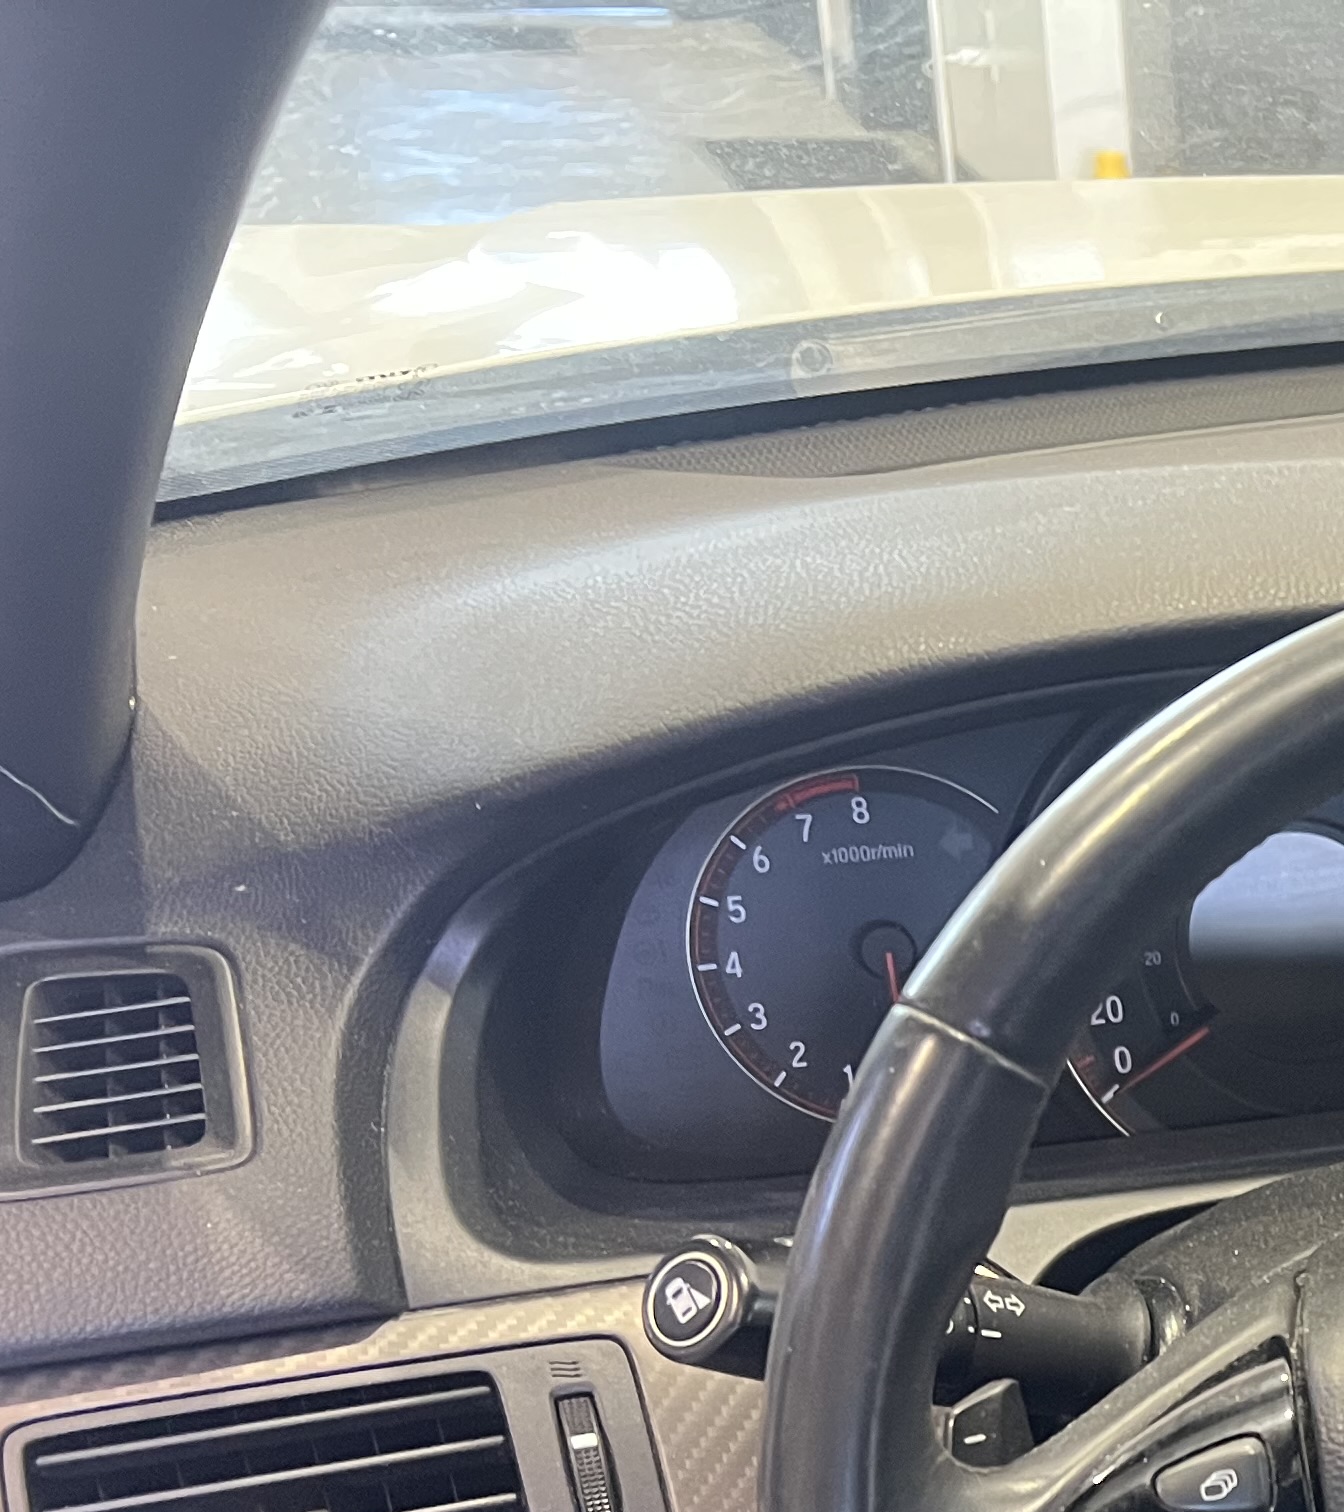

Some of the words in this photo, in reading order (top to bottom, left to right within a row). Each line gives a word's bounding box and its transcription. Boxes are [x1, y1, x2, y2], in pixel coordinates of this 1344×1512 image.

[850, 797, 871, 824] 8
[795, 814, 814, 842] 7
[753, 848, 771, 874] 6
[727, 895, 747, 923] 5
[725, 952, 743, 979] 4
[1144, 950, 1162, 967] 20
[747, 1004, 768, 1031] 3
[788, 1041, 808, 1068] 2
[1114, 1046, 1132, 1074] 0
